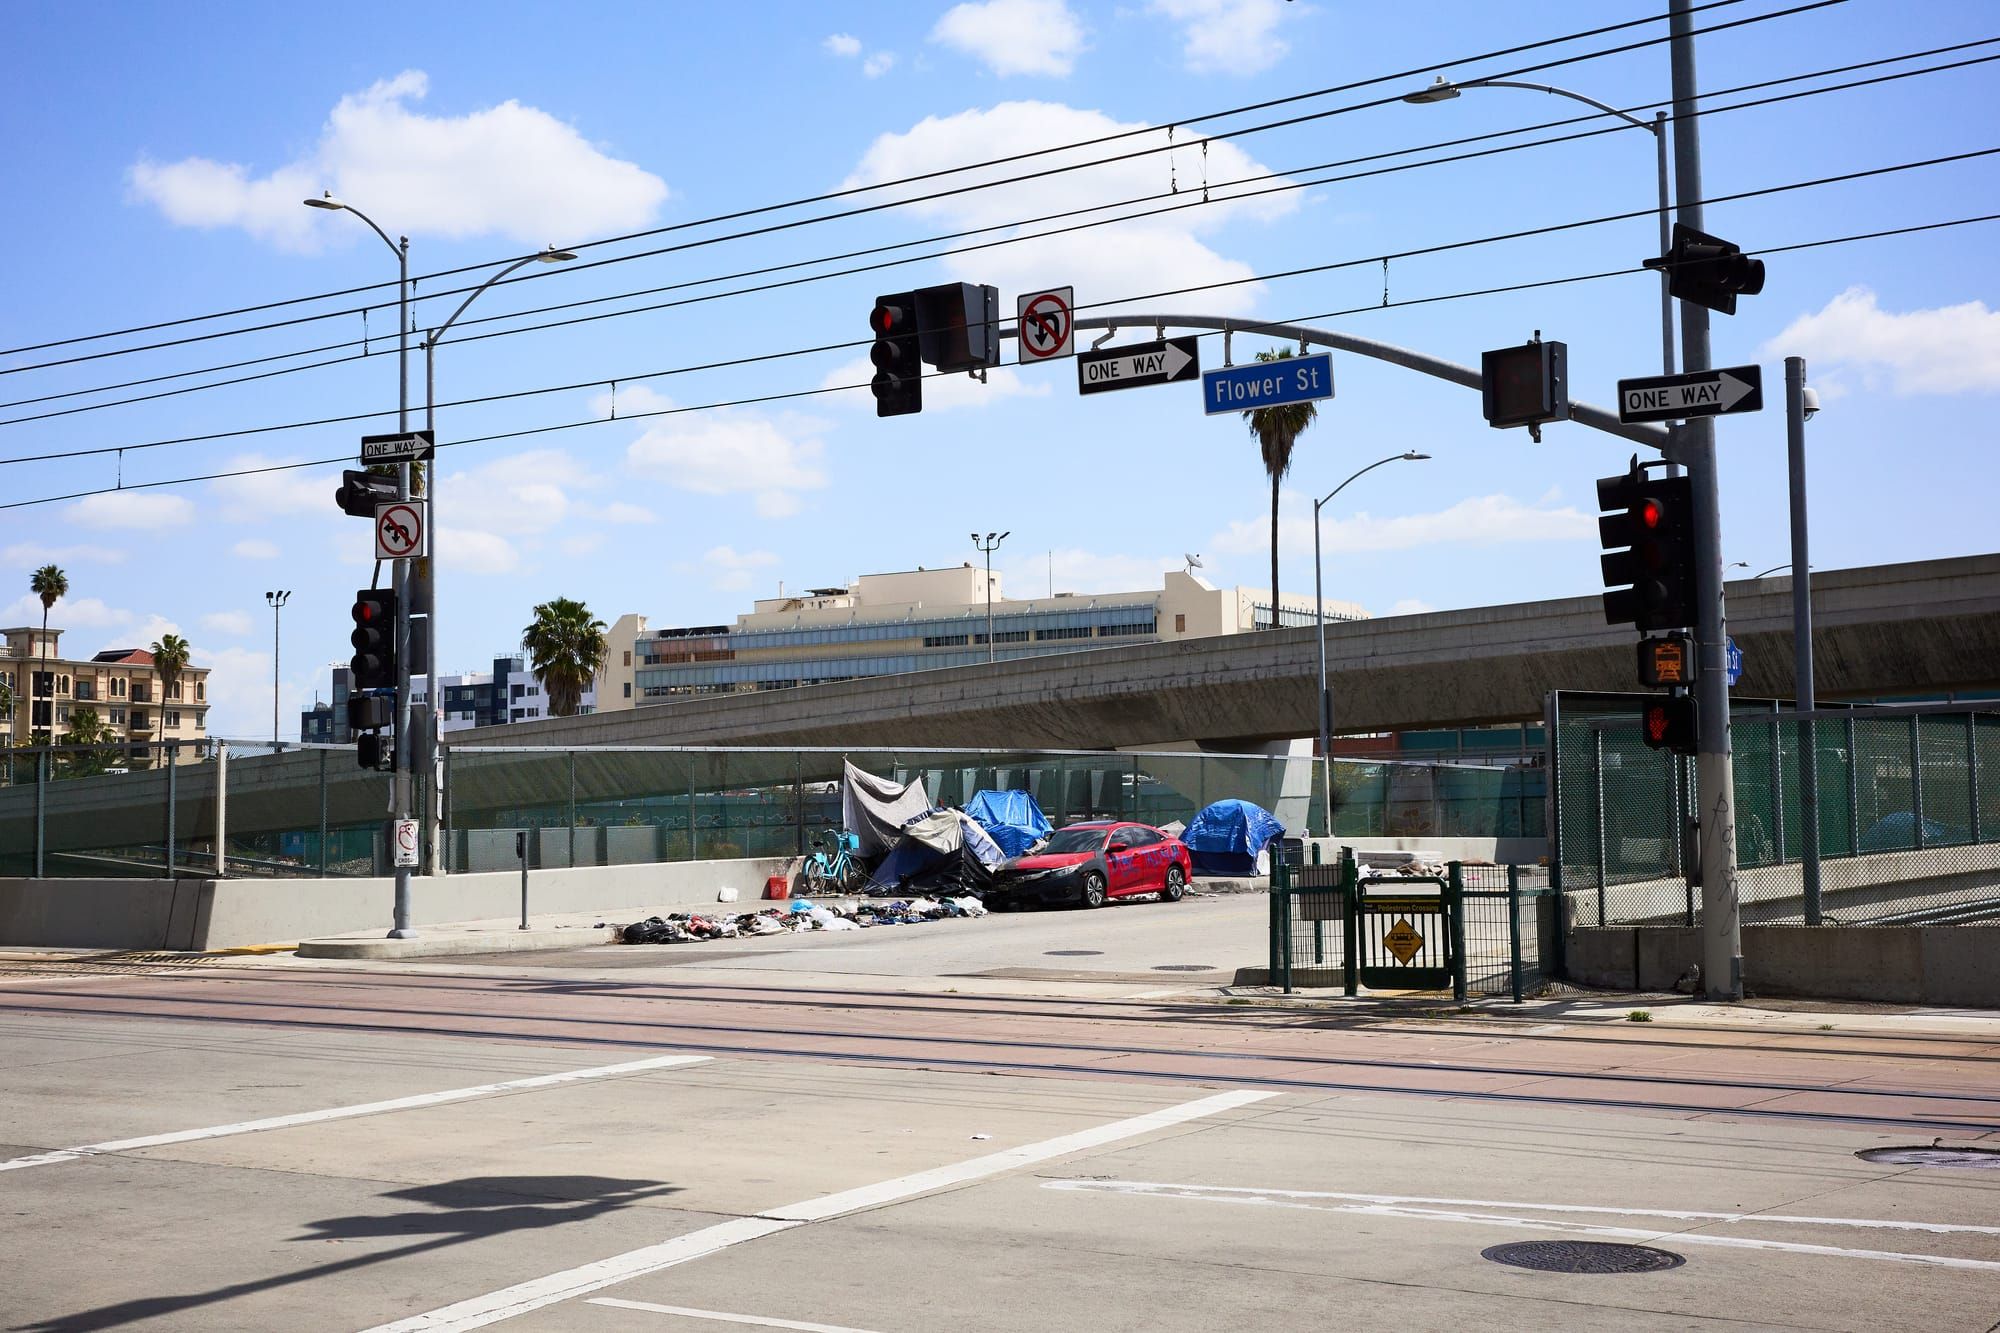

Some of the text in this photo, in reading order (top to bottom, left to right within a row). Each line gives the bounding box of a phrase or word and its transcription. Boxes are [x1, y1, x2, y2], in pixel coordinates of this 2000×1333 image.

[1089, 353, 1166, 381] ONE WAY
[1215, 367, 1319, 403] Flower St
[1629, 383, 1722, 410] ONE WAY
[366, 441, 416, 457] ONE WAY
[1377, 904, 1411, 912] Pedestrian
[1411, 904, 1439, 912] Crossing
